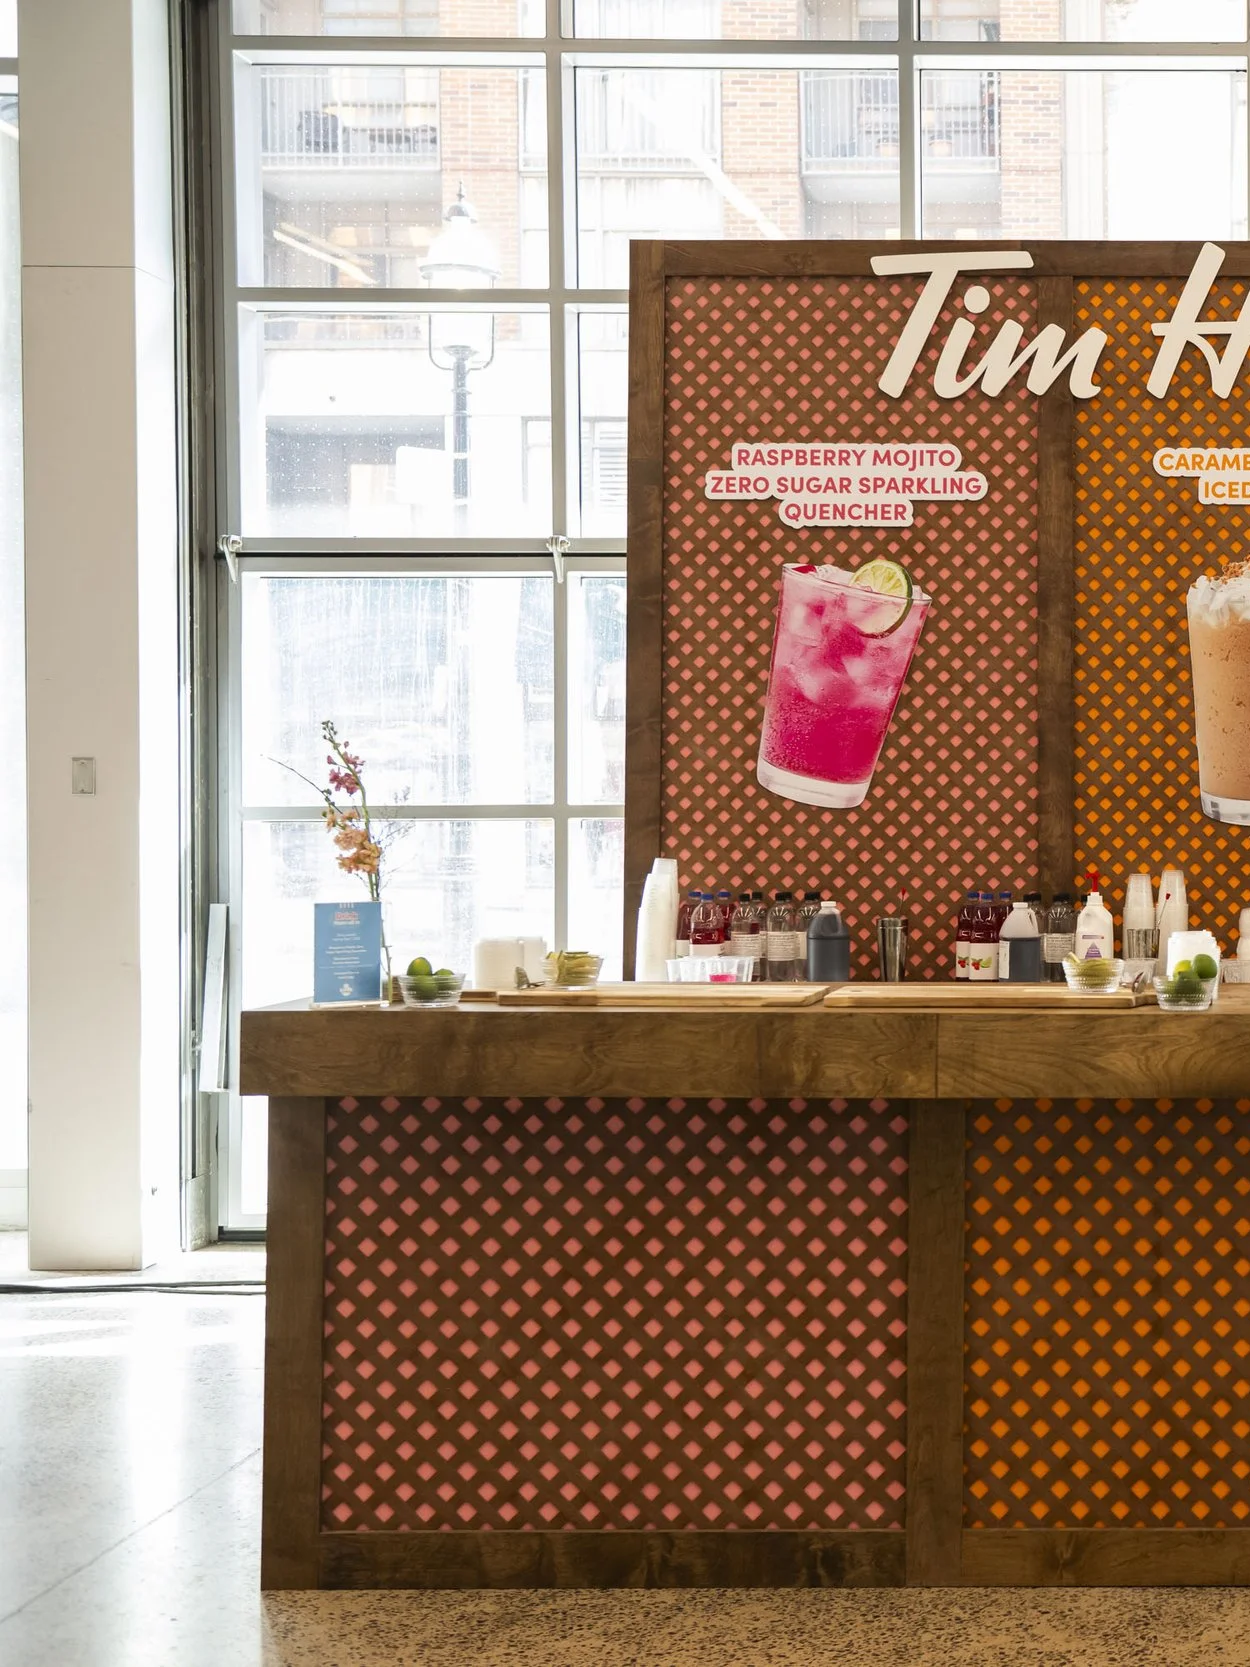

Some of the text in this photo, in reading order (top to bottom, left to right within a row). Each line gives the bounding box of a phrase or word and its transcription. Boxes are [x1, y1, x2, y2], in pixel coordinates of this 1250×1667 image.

[869, 249, 1108, 401] Tim
[737, 448, 956, 471] RASPBERRY MOJITO
[711, 477, 983, 496] ZERO SUGAR SPARKLING
[785, 503, 907, 523] QUENCHER
